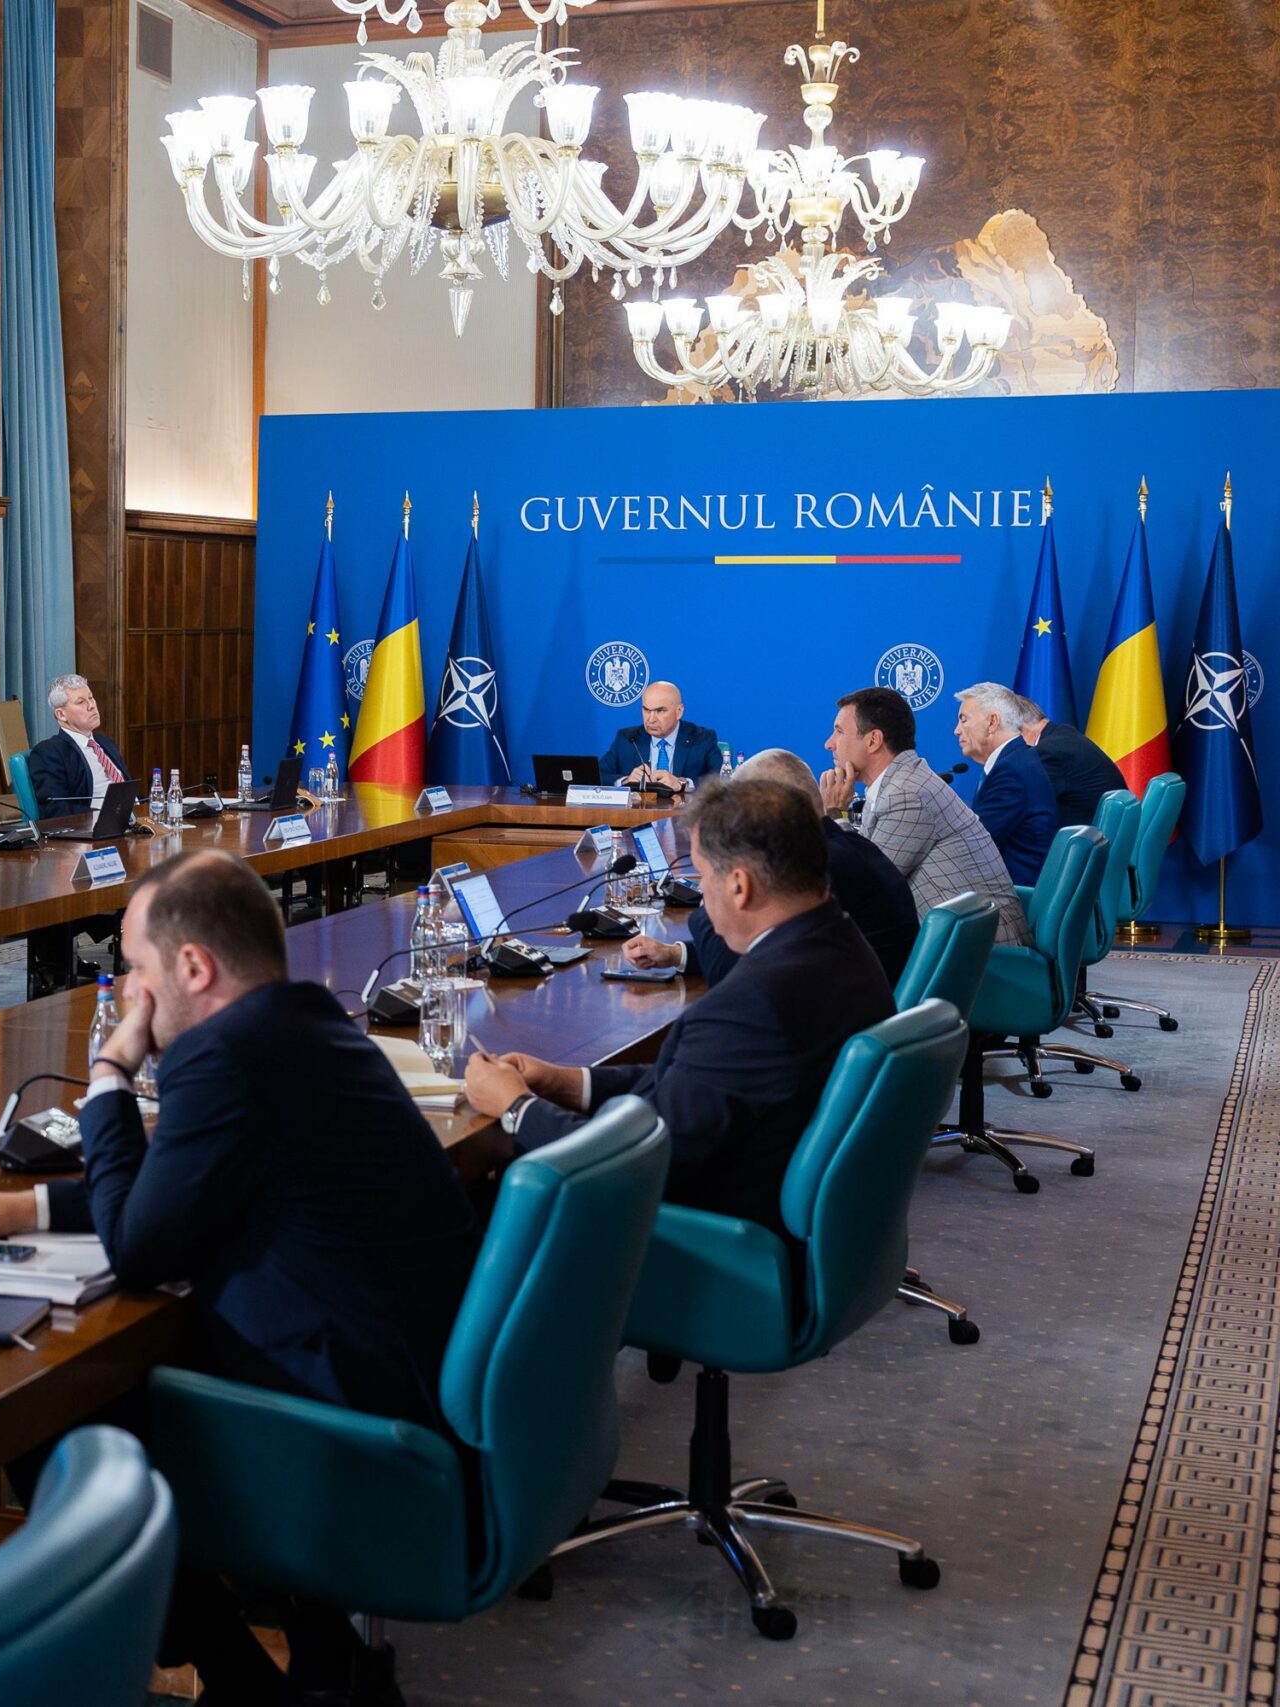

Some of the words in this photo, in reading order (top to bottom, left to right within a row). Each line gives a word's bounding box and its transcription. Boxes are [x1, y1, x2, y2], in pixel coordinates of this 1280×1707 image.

[520, 494, 776, 531] GUVERNUL
[592, 645, 643, 668] GUVERNUL
[882, 647, 937, 671] GUVERNUL
